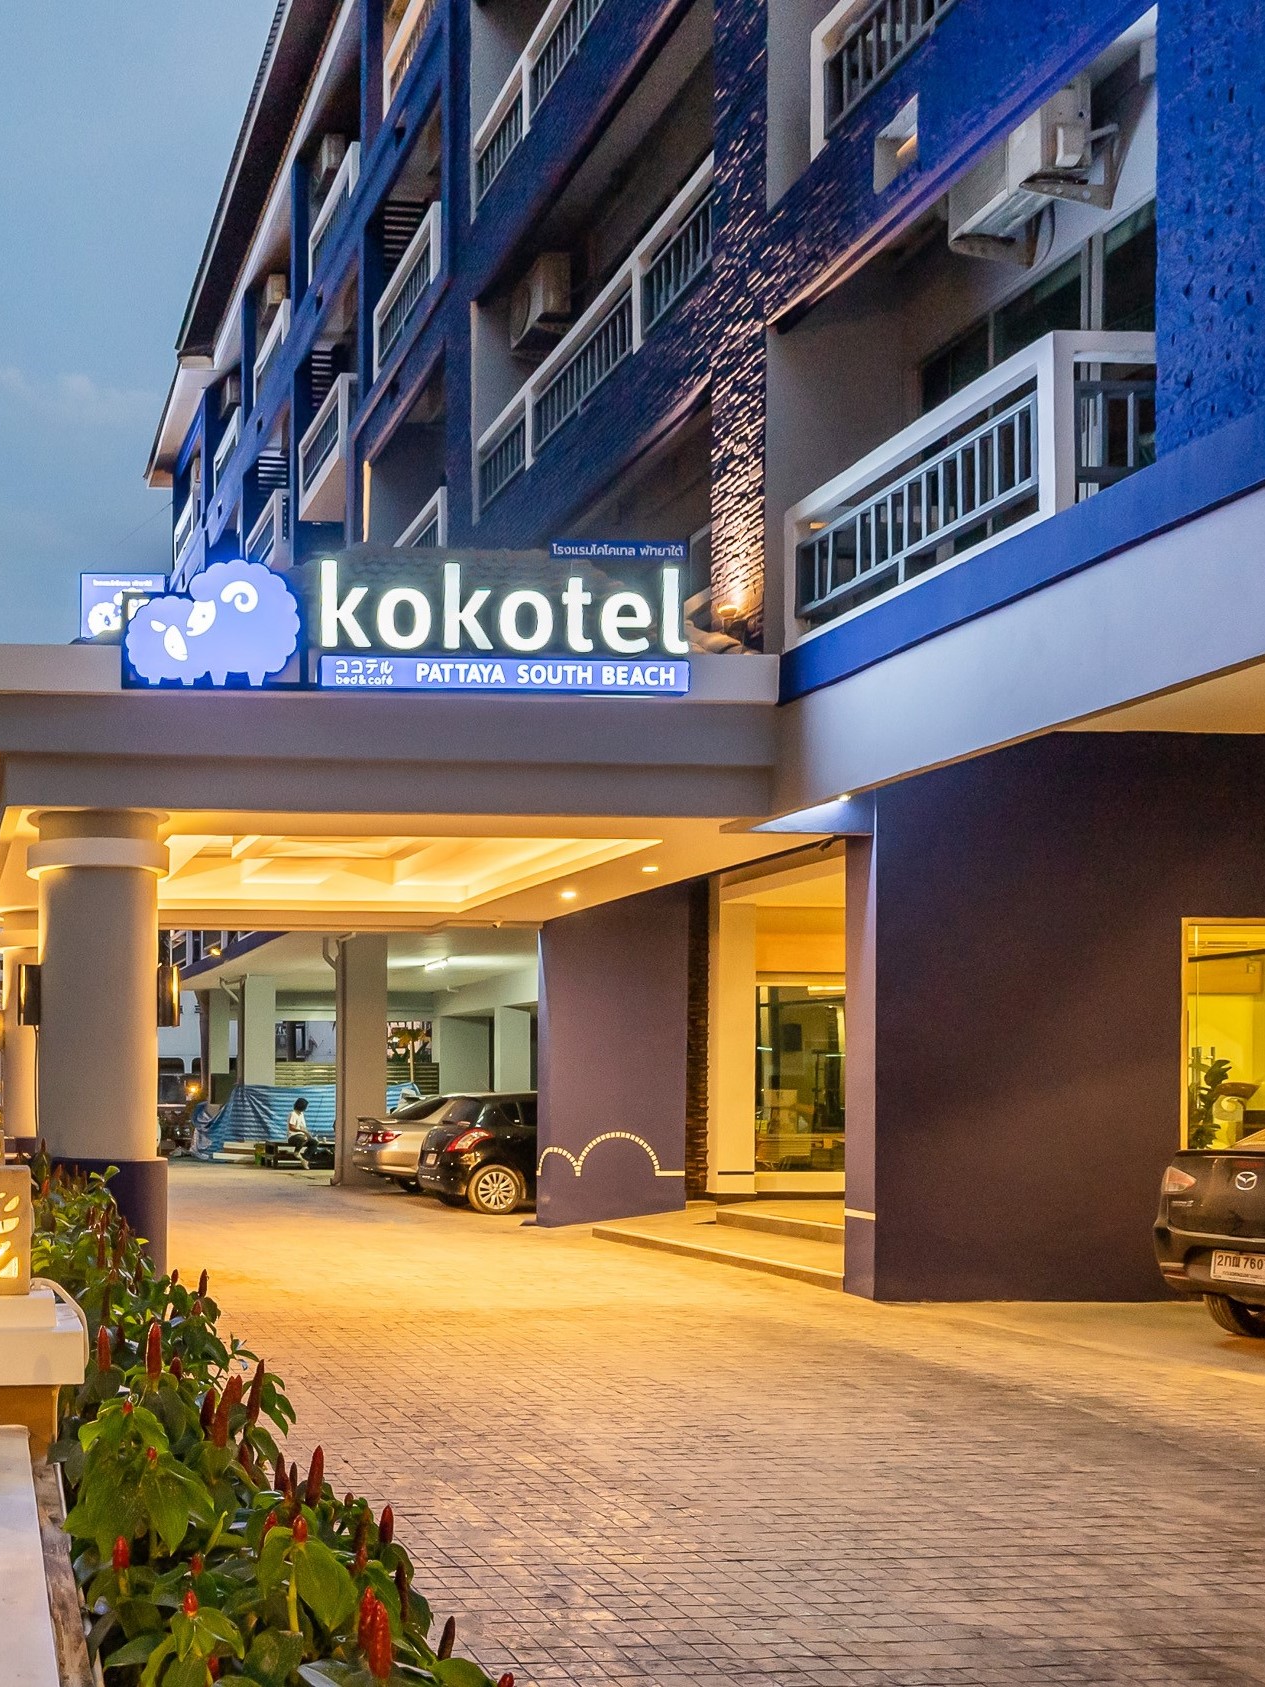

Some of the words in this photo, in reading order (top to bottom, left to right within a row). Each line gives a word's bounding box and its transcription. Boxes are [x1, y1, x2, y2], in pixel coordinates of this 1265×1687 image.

[320, 559, 689, 655] kokotel
[336, 659, 394, 675] ココテル
[416, 662, 506, 684] PATTAYA
[516, 663, 593, 685] SOUTH
[601, 665, 675, 686] BEACH
[1243, 1257, 1265, 1271] 760
